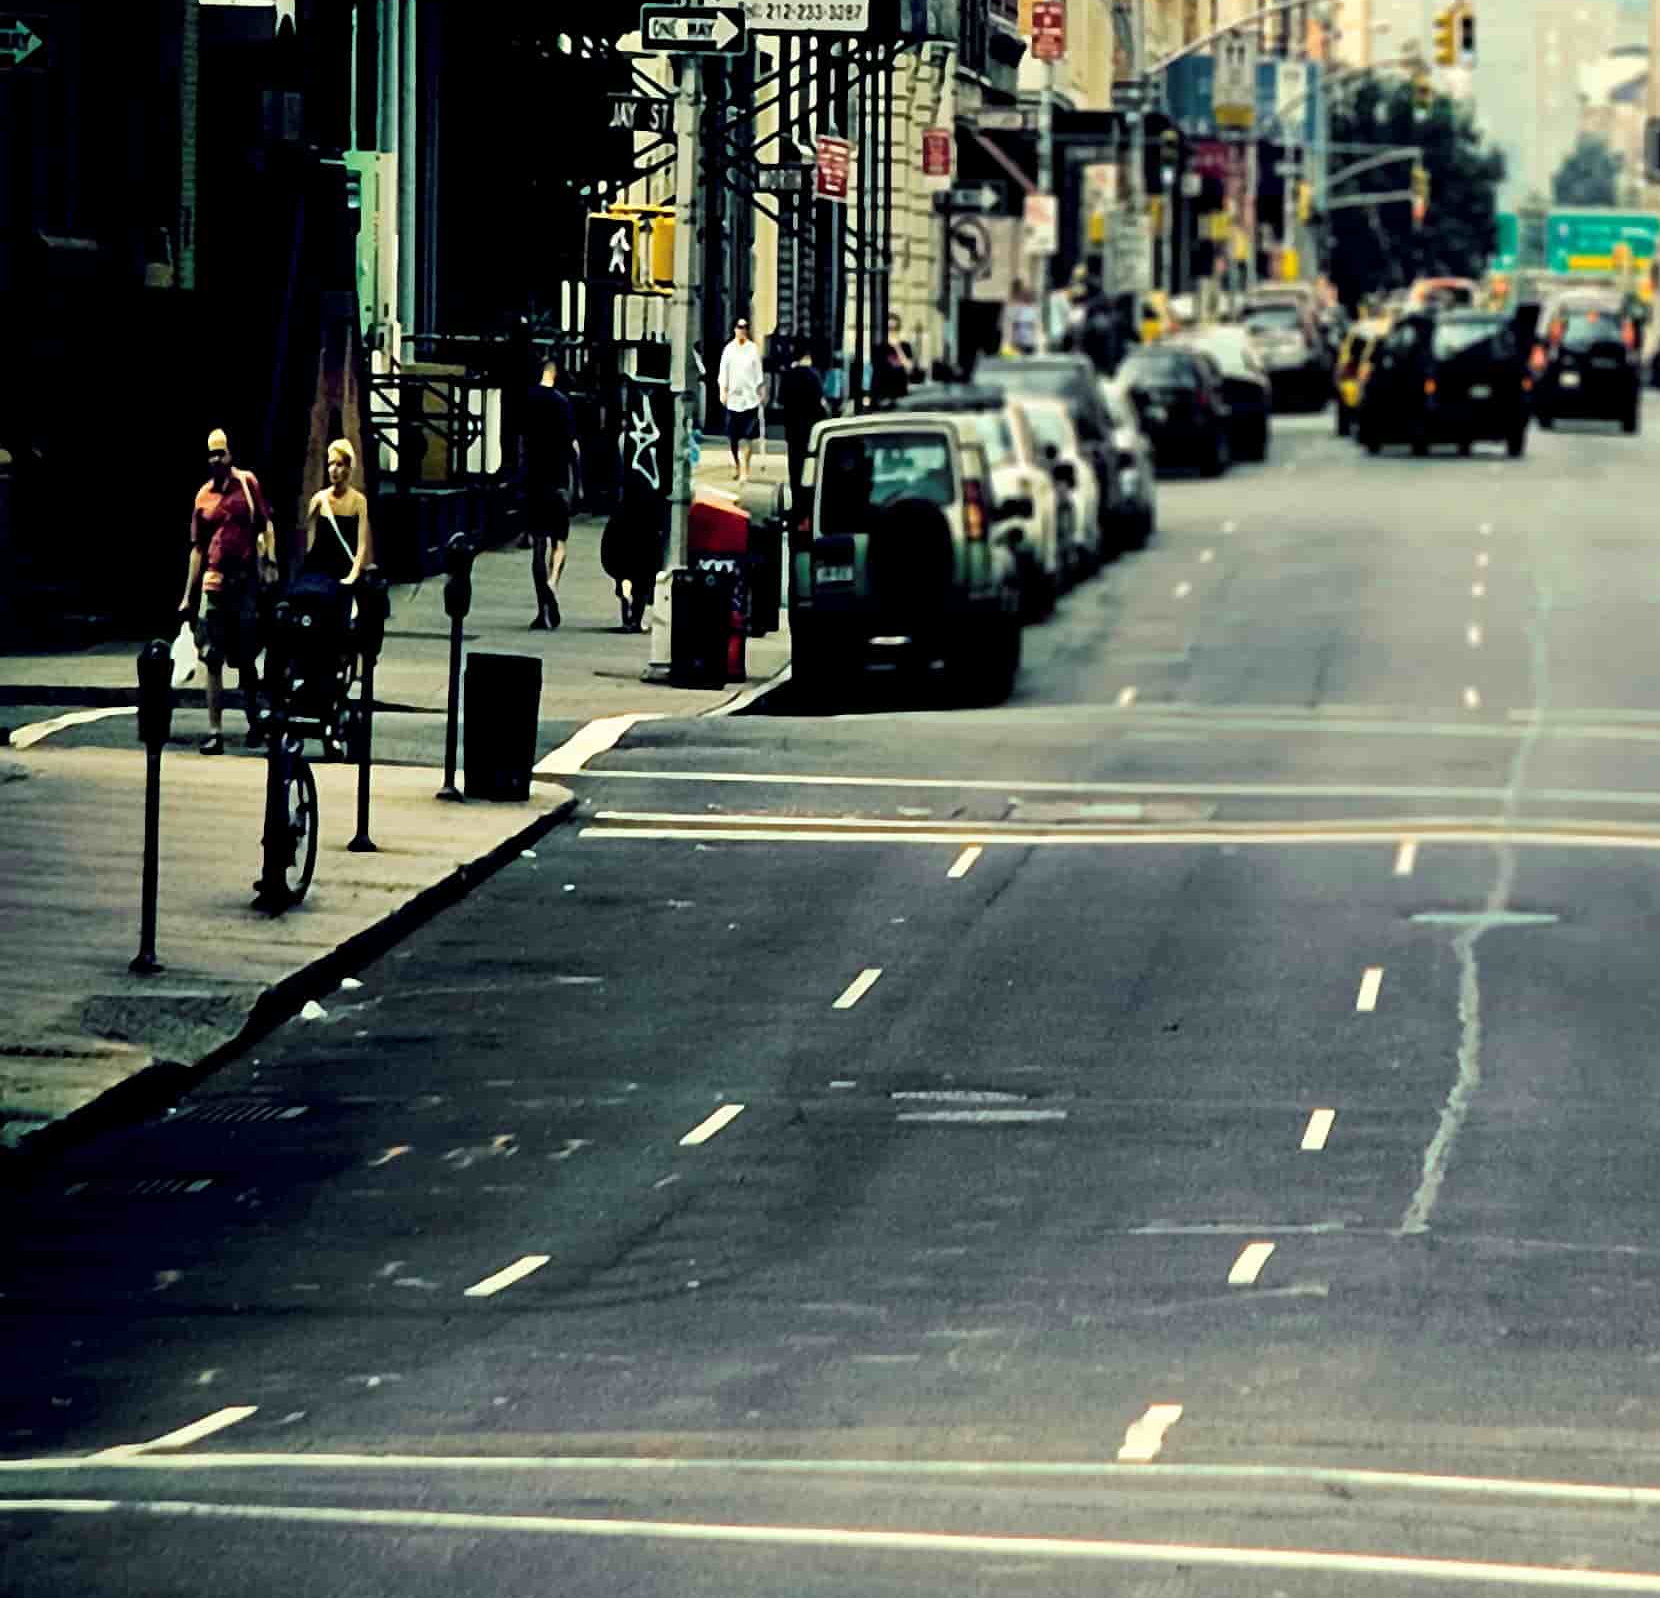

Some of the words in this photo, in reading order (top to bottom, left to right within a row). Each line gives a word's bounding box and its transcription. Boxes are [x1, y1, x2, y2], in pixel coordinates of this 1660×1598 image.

[652, 19, 677, 39] ONE
[687, 21, 715, 38] WAY
[608, 102, 637, 128] JAY
[648, 104, 669, 130] ST
